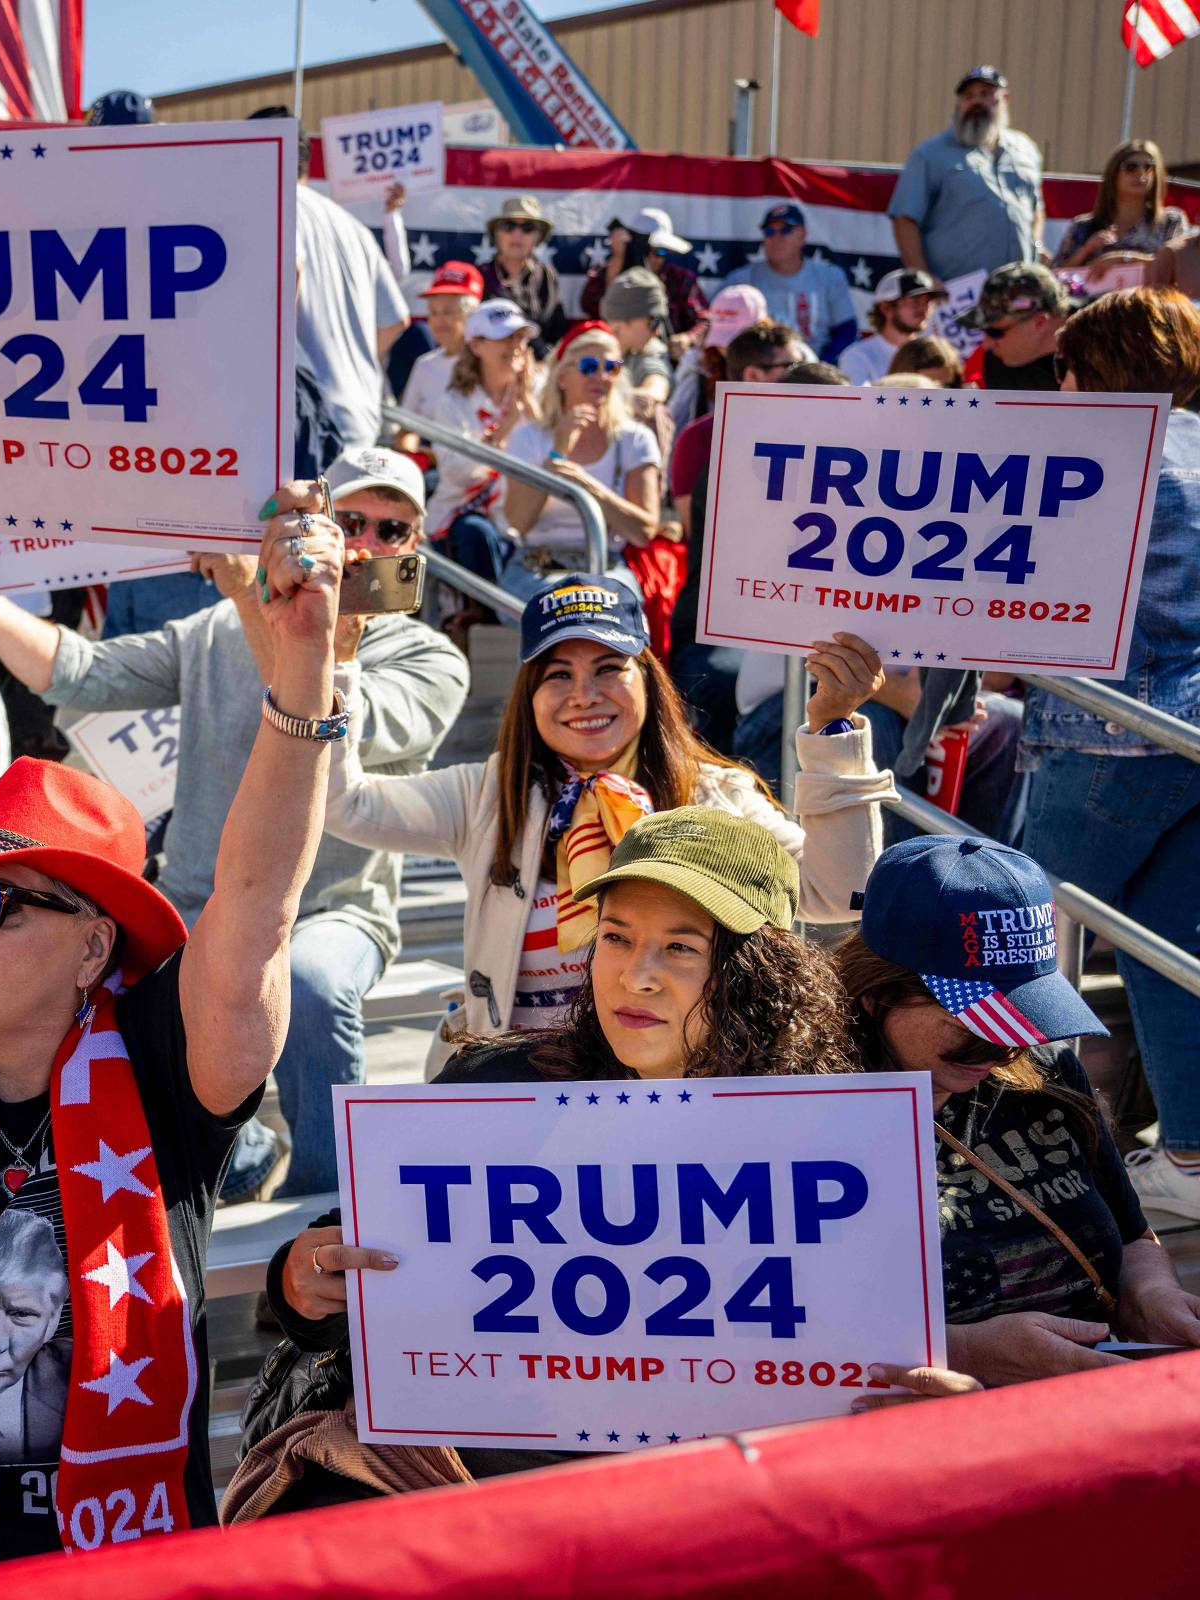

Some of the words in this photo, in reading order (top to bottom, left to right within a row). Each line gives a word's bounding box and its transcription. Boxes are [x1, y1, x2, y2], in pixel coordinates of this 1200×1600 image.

[503, 1, 550, 63] State
[551, 62, 618, 149] Rentals
[338, 123, 432, 154] TRUMP
[355, 147, 421, 174] 2024
[39, 441, 92, 470] TO
[108, 444, 239, 477] 88022
[754, 443, 1105, 518] TRUMP
[787, 511, 1038, 585] 2024
[539, 589, 619, 615] Trump
[563, 602, 593, 614] 2024
[736, 577, 805, 605] TEXT
[815, 586, 921, 613] TRUMP
[934, 597, 975, 618] TO
[987, 599, 1092, 624] 88022
[977, 902, 1053, 934] TRUMP
[982, 942, 1057, 966] PRESIDENT
[983, 935, 1000, 949] IS
[1006, 931, 1043, 948] STILL
[399, 1160, 869, 1246] TRUMP
[471, 1255, 807, 1339] 2024
[403, 1351, 502, 1378] TEXT
[519, 1354, 665, 1383] TRUMP
[680, 1357, 736, 1384] TO
